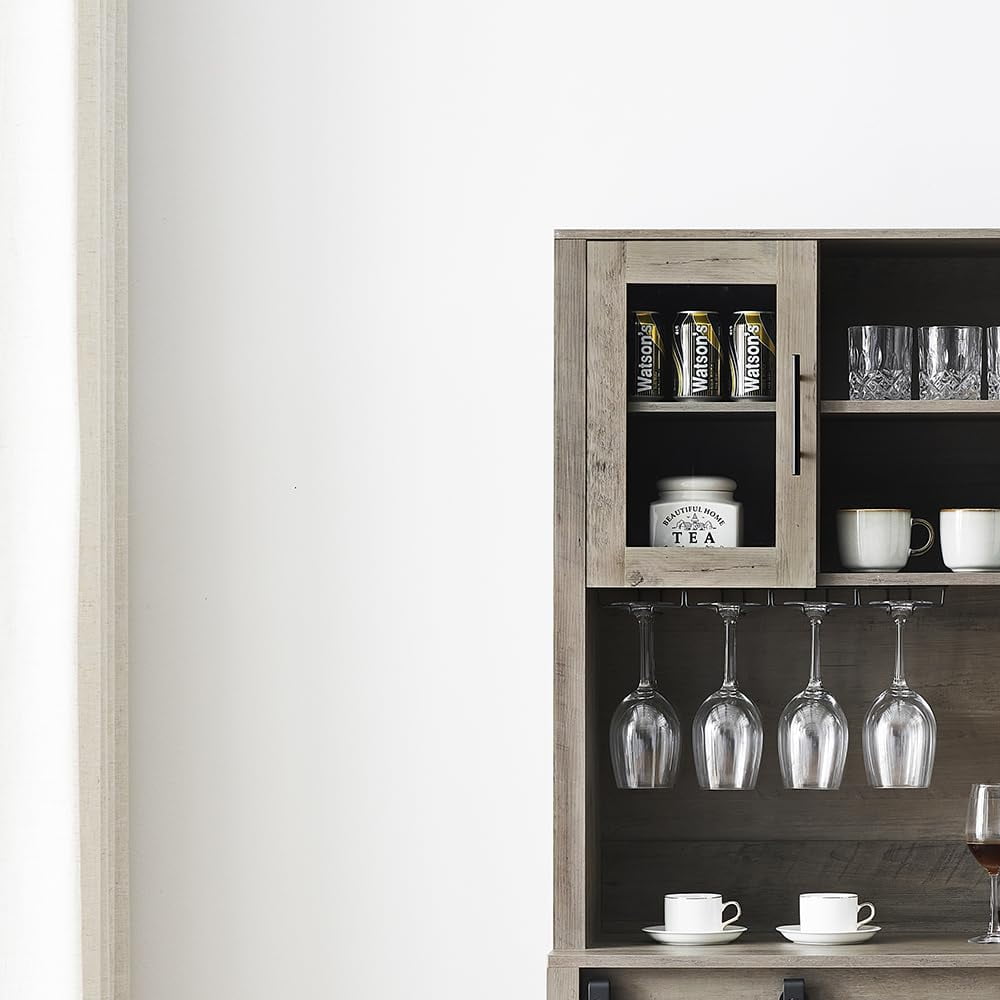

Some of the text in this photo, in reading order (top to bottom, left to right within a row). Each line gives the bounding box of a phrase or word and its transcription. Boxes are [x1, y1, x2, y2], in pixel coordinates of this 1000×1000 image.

[637, 324, 653, 393] Watson's
[692, 324, 709, 394] Watson's
[743, 324, 761, 393] Watson's
[662, 505, 726, 527] BEAUTIFUL HOME
[672, 531, 716, 544] TEA
